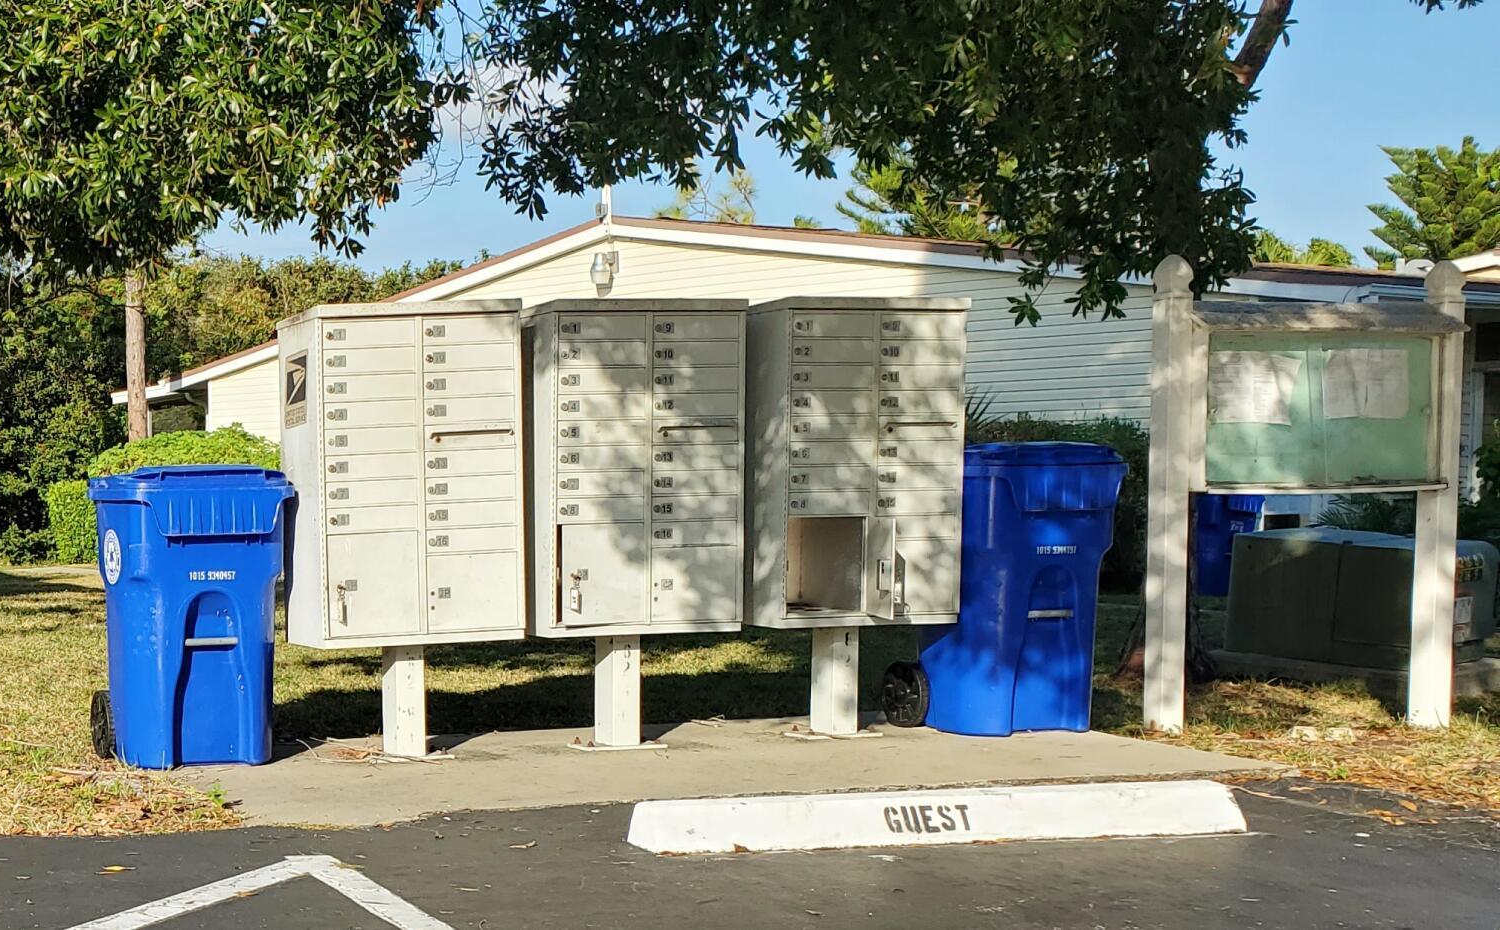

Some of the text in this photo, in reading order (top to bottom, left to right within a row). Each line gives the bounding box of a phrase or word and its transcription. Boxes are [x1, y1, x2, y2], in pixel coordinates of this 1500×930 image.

[663, 349, 673, 359] 10
[663, 375, 673, 385] 11
[663, 400, 673, 410] 12
[662, 452, 672, 462] 13
[662, 504, 672, 514] 15
[1036, 545, 1051, 555] 1015
[189, 571, 206, 581] 1015
[883, 804, 971, 834] GUEST
